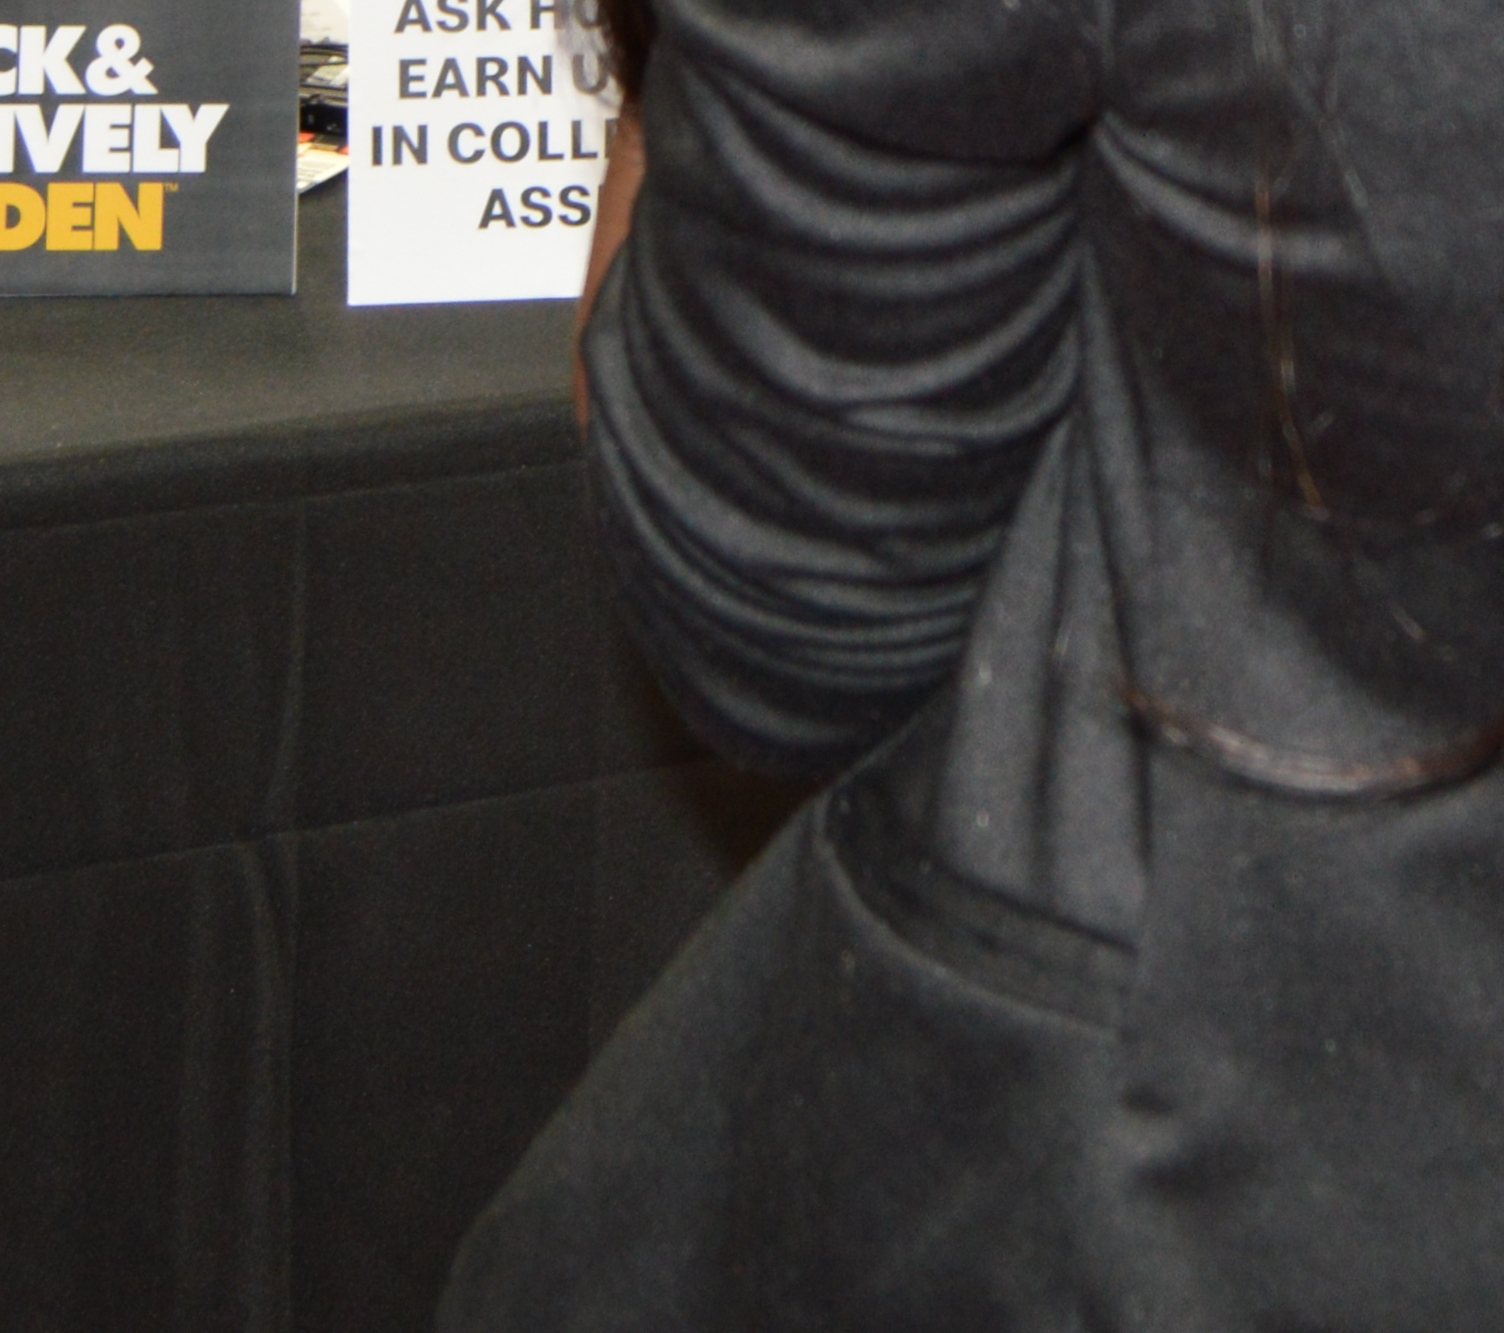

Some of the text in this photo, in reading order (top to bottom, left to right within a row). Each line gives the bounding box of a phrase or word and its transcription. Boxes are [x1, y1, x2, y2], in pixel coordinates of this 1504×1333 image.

[398, 53, 609, 99] EARN U
[371, 117, 618, 167] IN COLL
[478, 184, 601, 230] ASS
